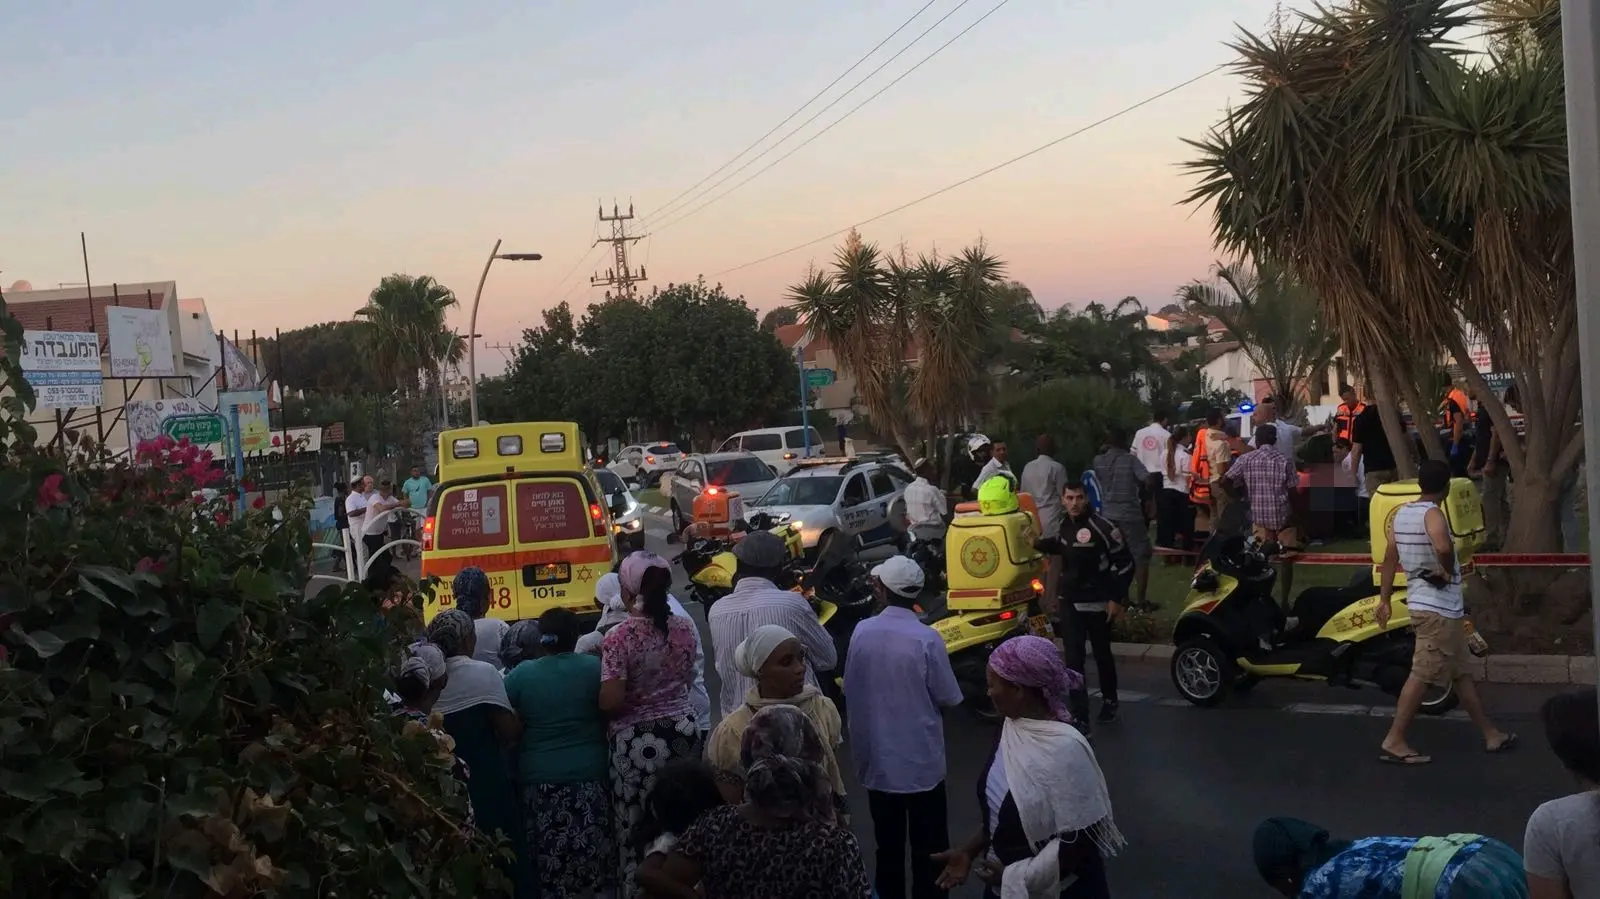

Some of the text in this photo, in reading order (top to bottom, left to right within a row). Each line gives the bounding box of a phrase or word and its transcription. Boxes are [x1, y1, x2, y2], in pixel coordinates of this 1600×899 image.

[34, 340, 99, 358] המעבדה
[548, 499, 565, 507] נאמן
[531, 586, 554, 599] 101
